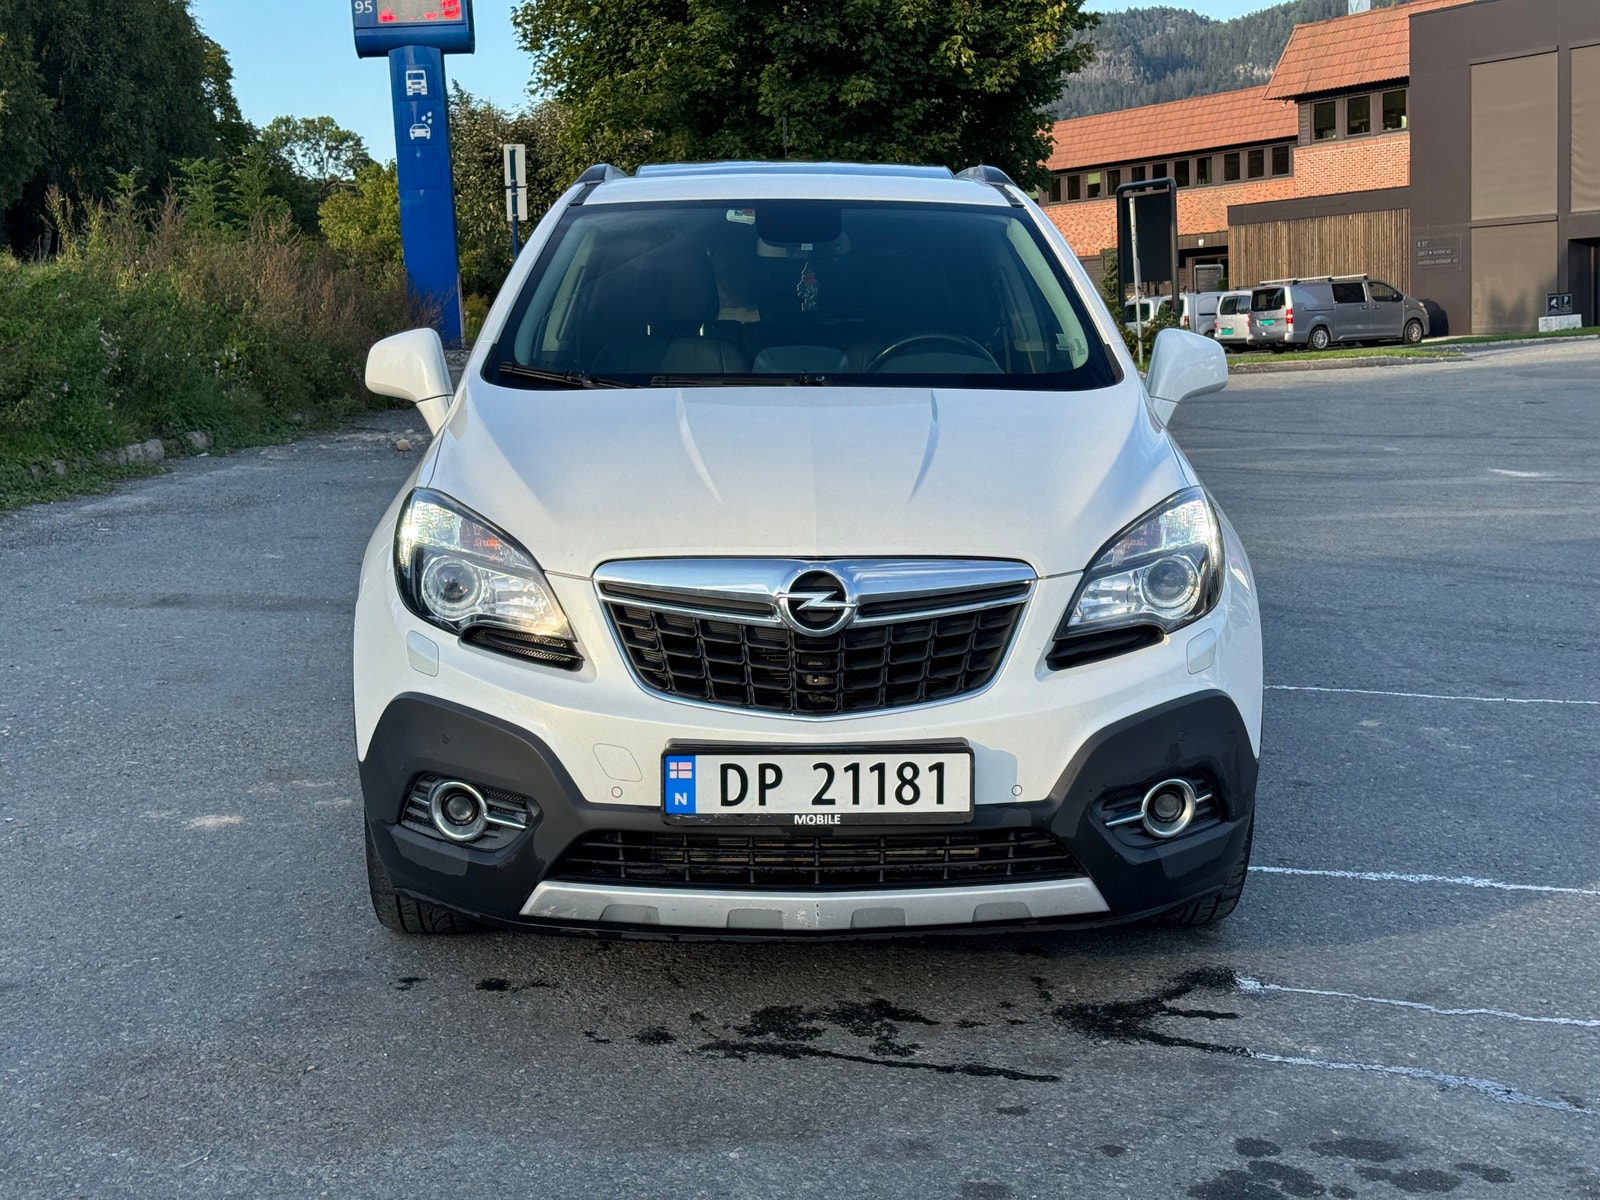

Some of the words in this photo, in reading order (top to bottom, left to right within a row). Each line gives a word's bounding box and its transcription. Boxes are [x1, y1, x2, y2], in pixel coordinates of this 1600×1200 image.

[354, 0, 373, 14] 95
[720, 763, 782, 806] DP
[812, 762, 944, 805] 21181
[674, 792, 687, 805] N
[794, 814, 841, 825] MOBILE
